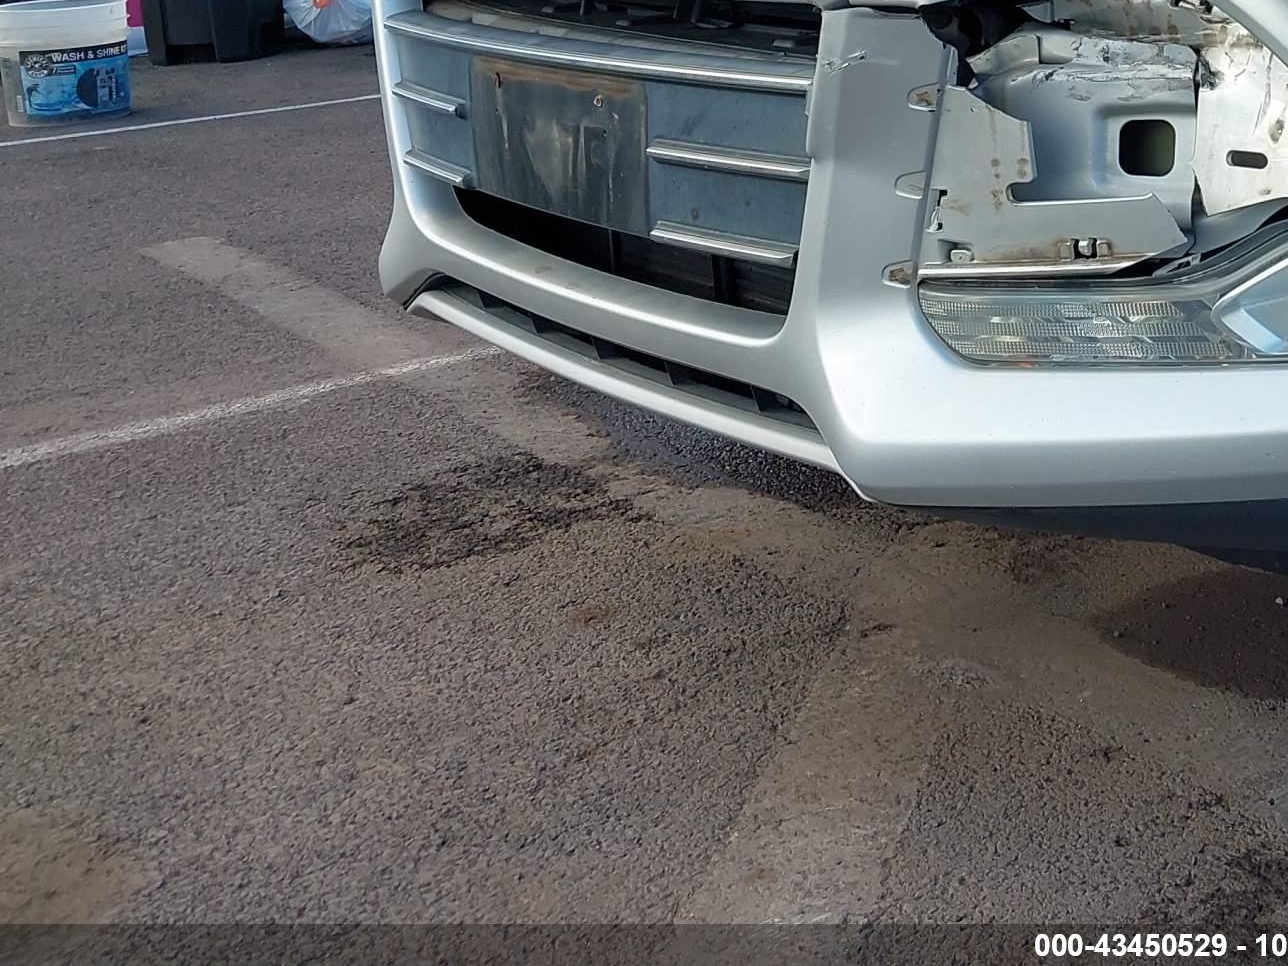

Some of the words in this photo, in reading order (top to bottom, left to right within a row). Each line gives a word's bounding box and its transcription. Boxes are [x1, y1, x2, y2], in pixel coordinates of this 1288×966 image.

[51, 51, 85, 63] WASH
[87, 50, 95, 59] &
[97, 47, 121, 58] SHINE
